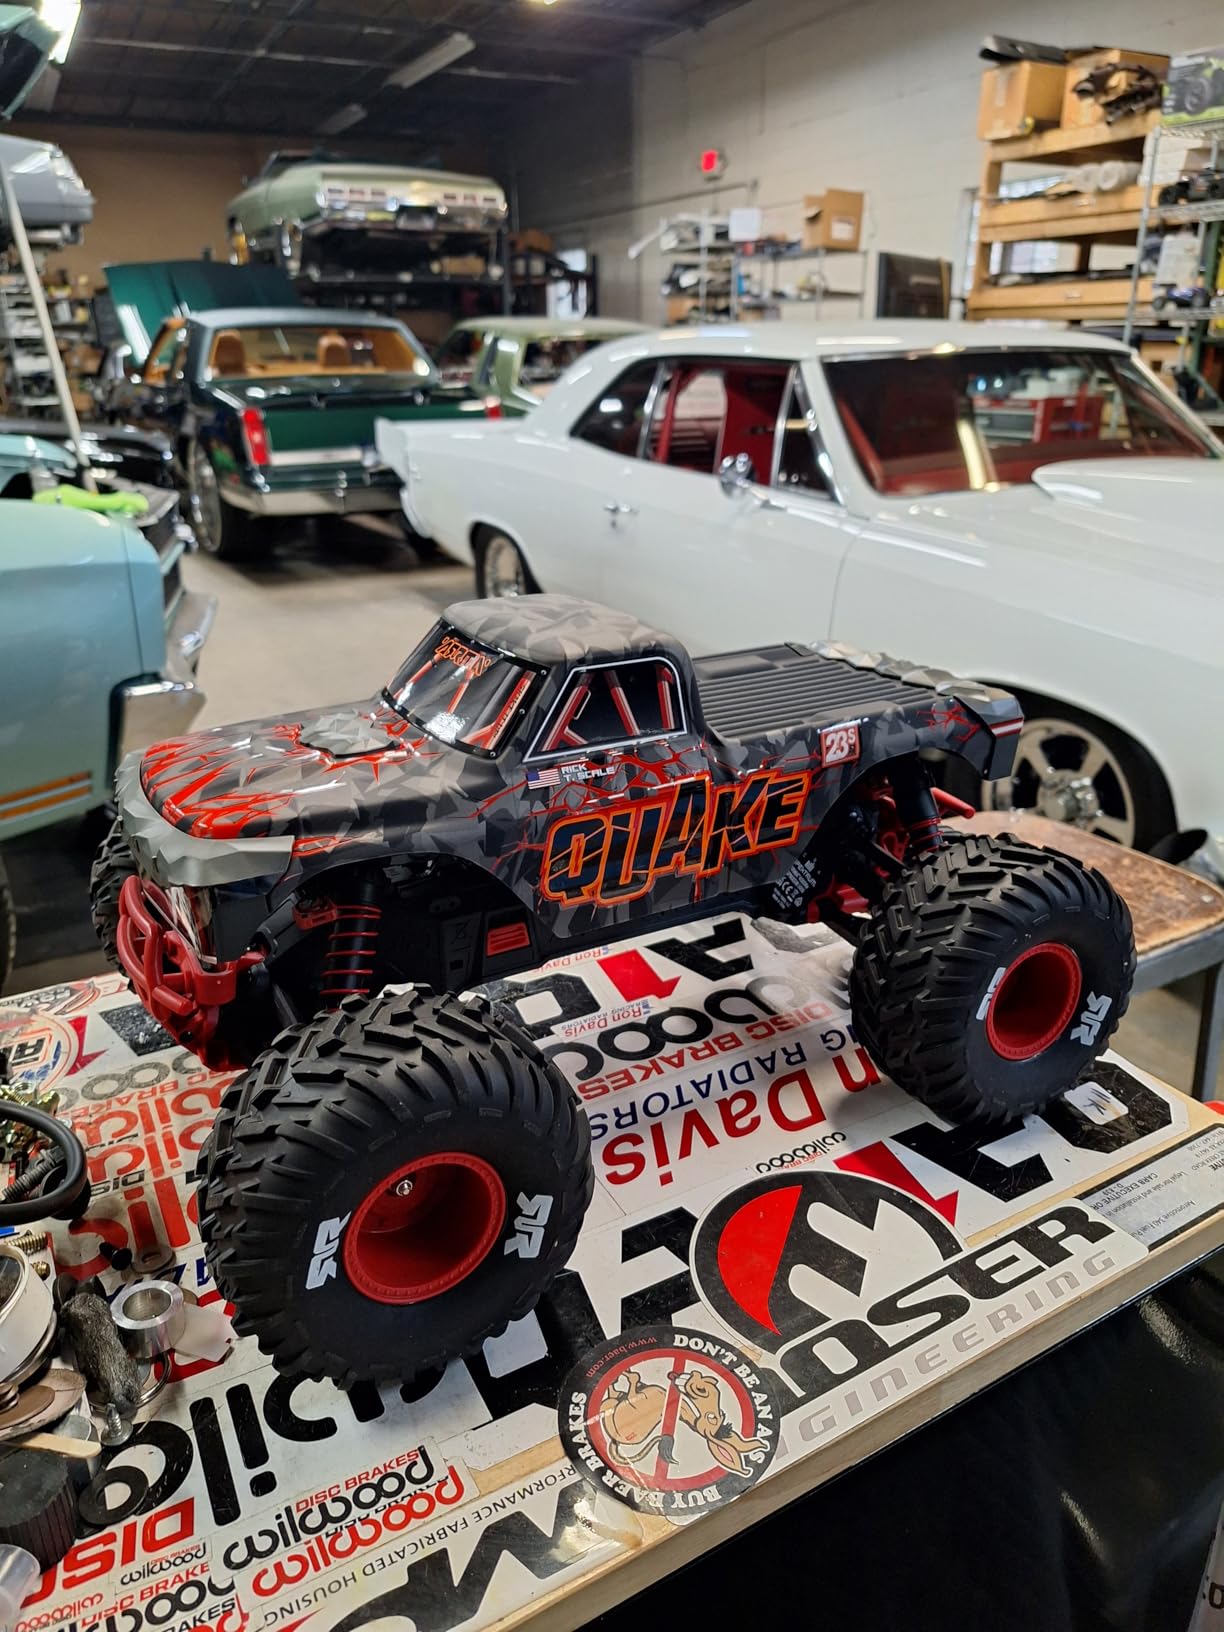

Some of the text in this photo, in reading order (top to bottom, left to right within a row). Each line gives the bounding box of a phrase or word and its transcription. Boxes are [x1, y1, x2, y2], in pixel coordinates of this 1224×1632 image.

[561, 763, 587, 775] RICK
[577, 766, 615, 780] SCALE
[544, 771, 811, 907] QUAKE
[575, 948, 602, 963] Ron
[564, 1005, 643, 1038] Ron Davis
[745, 1002, 833, 1041] DISC
[577, 1031, 744, 1101] BRAKES
[588, 1043, 807, 1141] RADIATORS
[601, 1068, 826, 1187] Davis
[755, 1131, 847, 1174] wilwood
[1101, 1182, 1140, 1205] EXECUTIVE
[1137, 1172, 1158, 1185] CARB
[585, 1336, 658, 1378] www.baer.com
[673, 1334, 738, 1367] DON'T
[734, 1362, 760, 1389] BE
[752, 1391, 773, 1420] AN
[569, 1391, 722, 1509] BUY BAER BRAKES
[222, 1444, 435, 1571] wilwood
[296, 1484, 342, 1514] DISC
[345, 1448, 419, 1491] BRAKES
[251, 1464, 465, 1598] wilwood
[362, 1517, 469, 1577] FABRICATED
[120, 1542, 207, 1586] wilwood
[81, 1595, 134, 1629] DISC
[140, 1562, 210, 1601] BRAKE
[264, 1571, 358, 1627] HOUSING
